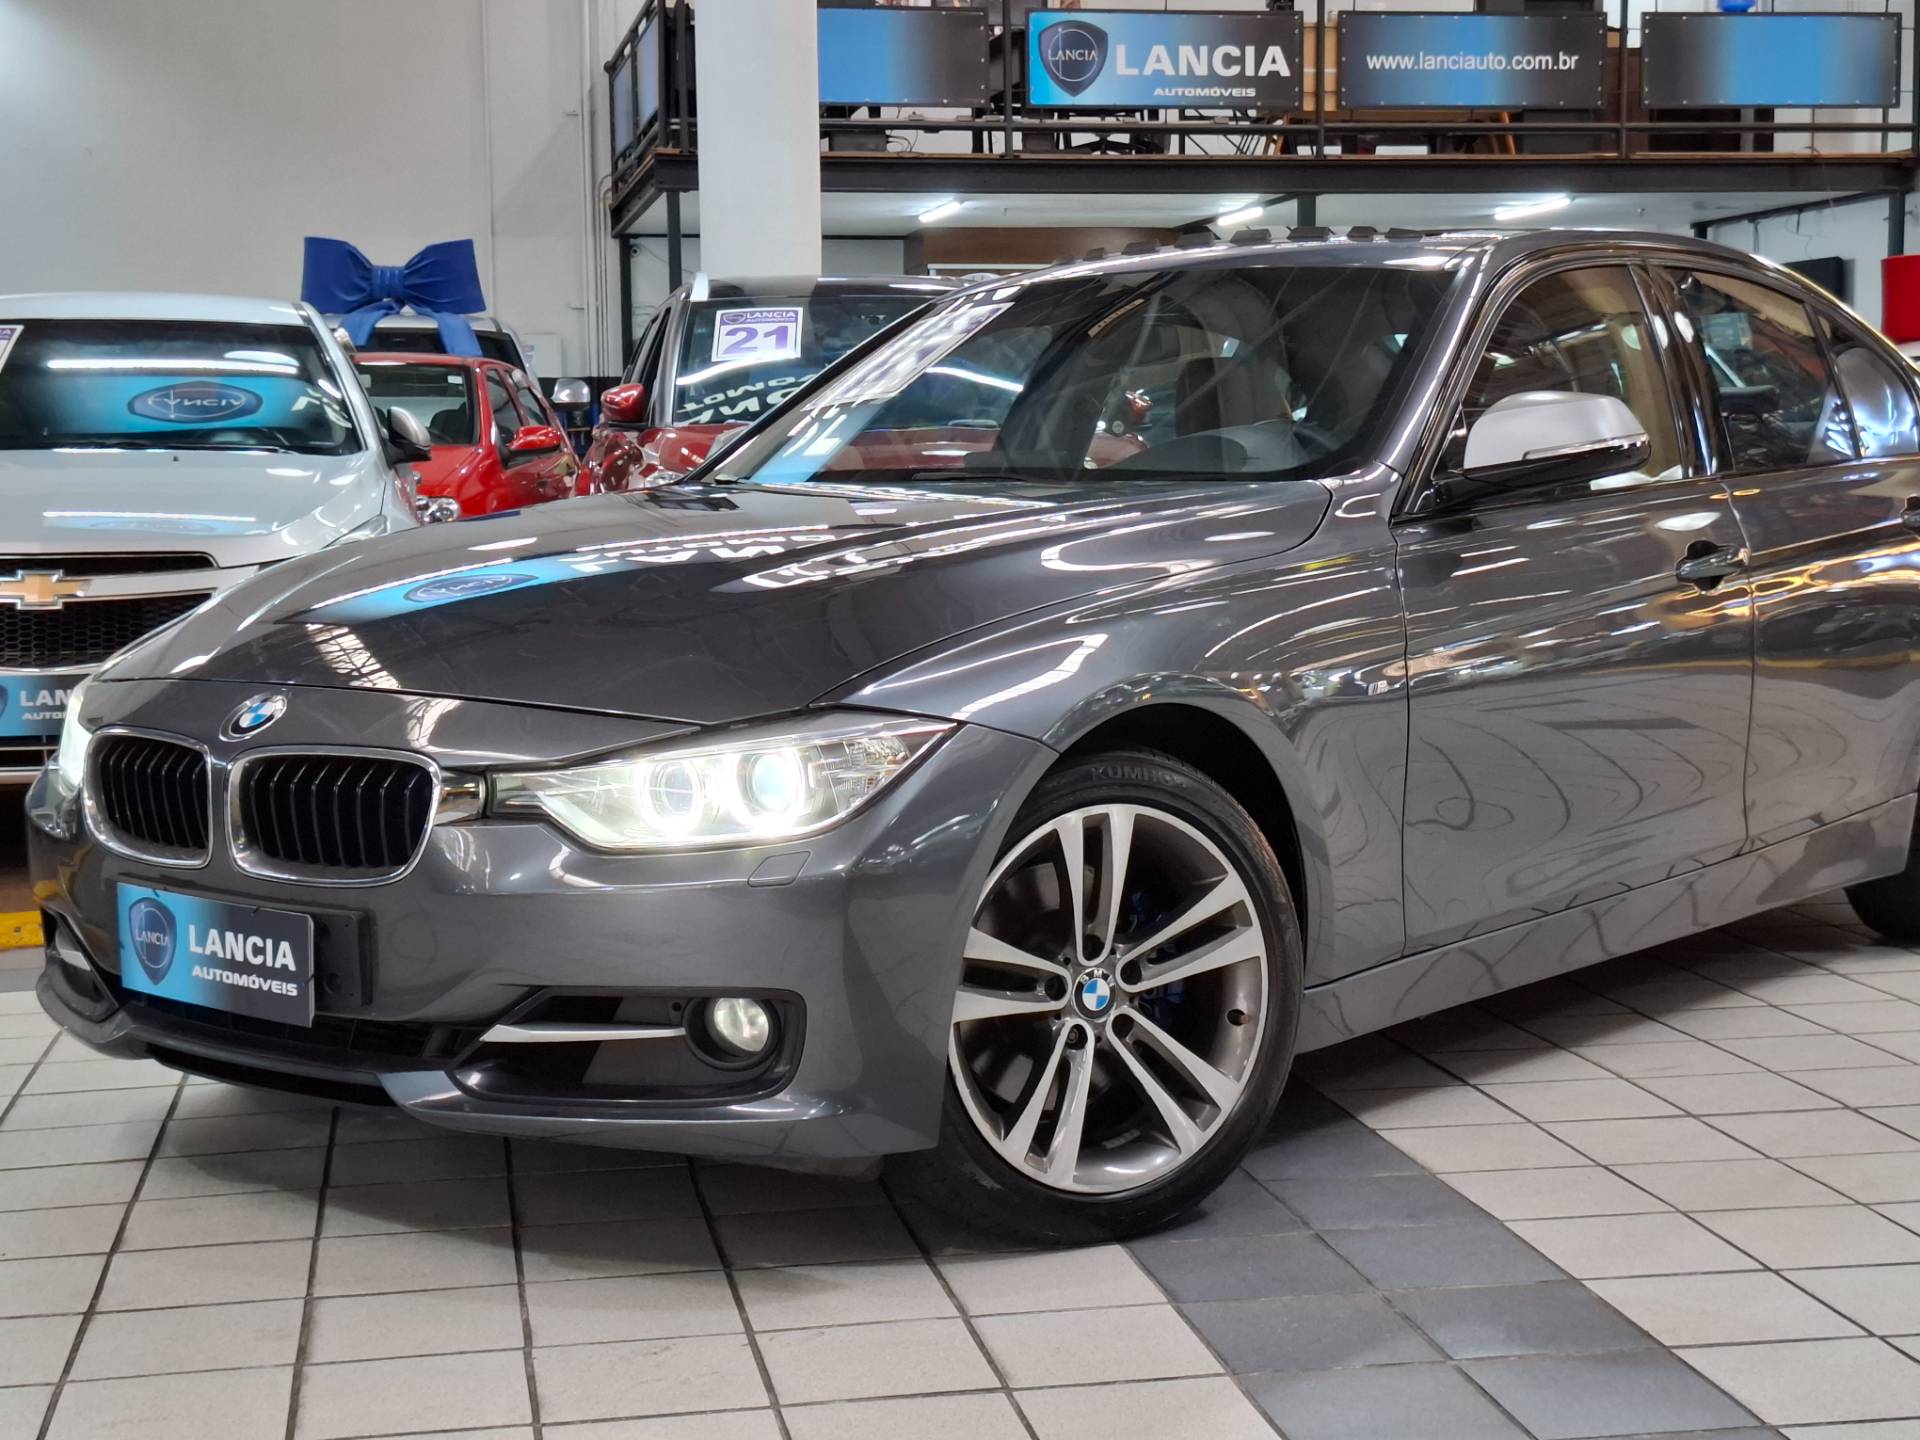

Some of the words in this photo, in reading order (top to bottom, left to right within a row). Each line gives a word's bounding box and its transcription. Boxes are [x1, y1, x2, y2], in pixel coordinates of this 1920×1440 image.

[1048, 48, 1099, 62] LANCIA
[1115, 44, 1291, 77] LANCIA
[1366, 51, 1579, 71] www.lanciauto.com.br
[1153, 86, 1257, 98] AUTOMÓVEIS
[746, 311, 796, 319] LANCIA
[722, 325, 789, 355] 21
[1090, 766, 1175, 787] KUMHO
[135, 928, 171, 947] LANCIA
[188, 923, 297, 972] LANCIA
[192, 964, 298, 997] AUTOMÓVEIS
